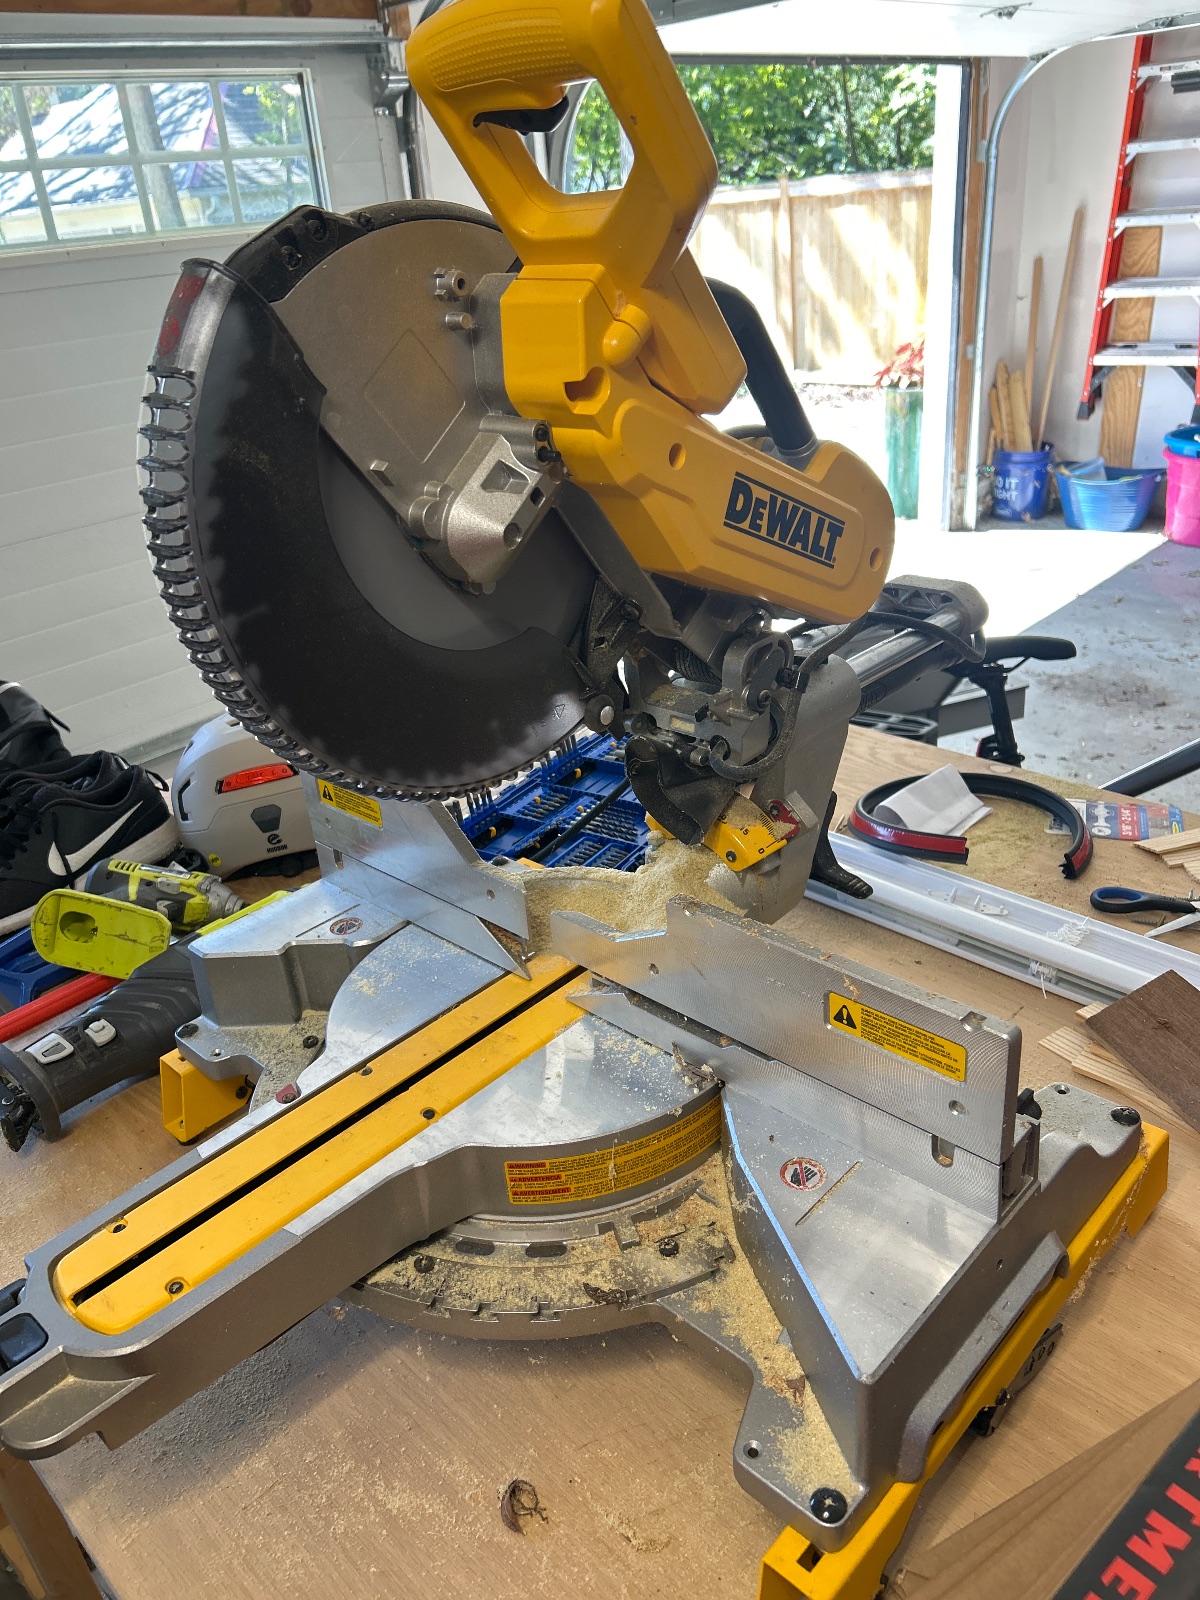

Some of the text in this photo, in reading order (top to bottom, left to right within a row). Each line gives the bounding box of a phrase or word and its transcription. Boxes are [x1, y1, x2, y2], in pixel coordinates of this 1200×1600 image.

[724, 477, 845, 563] DEWALT
[518, 1174, 562, 1183] ADVERTENCIA
[519, 1187, 571, 1197] AVERTISSEMENT
